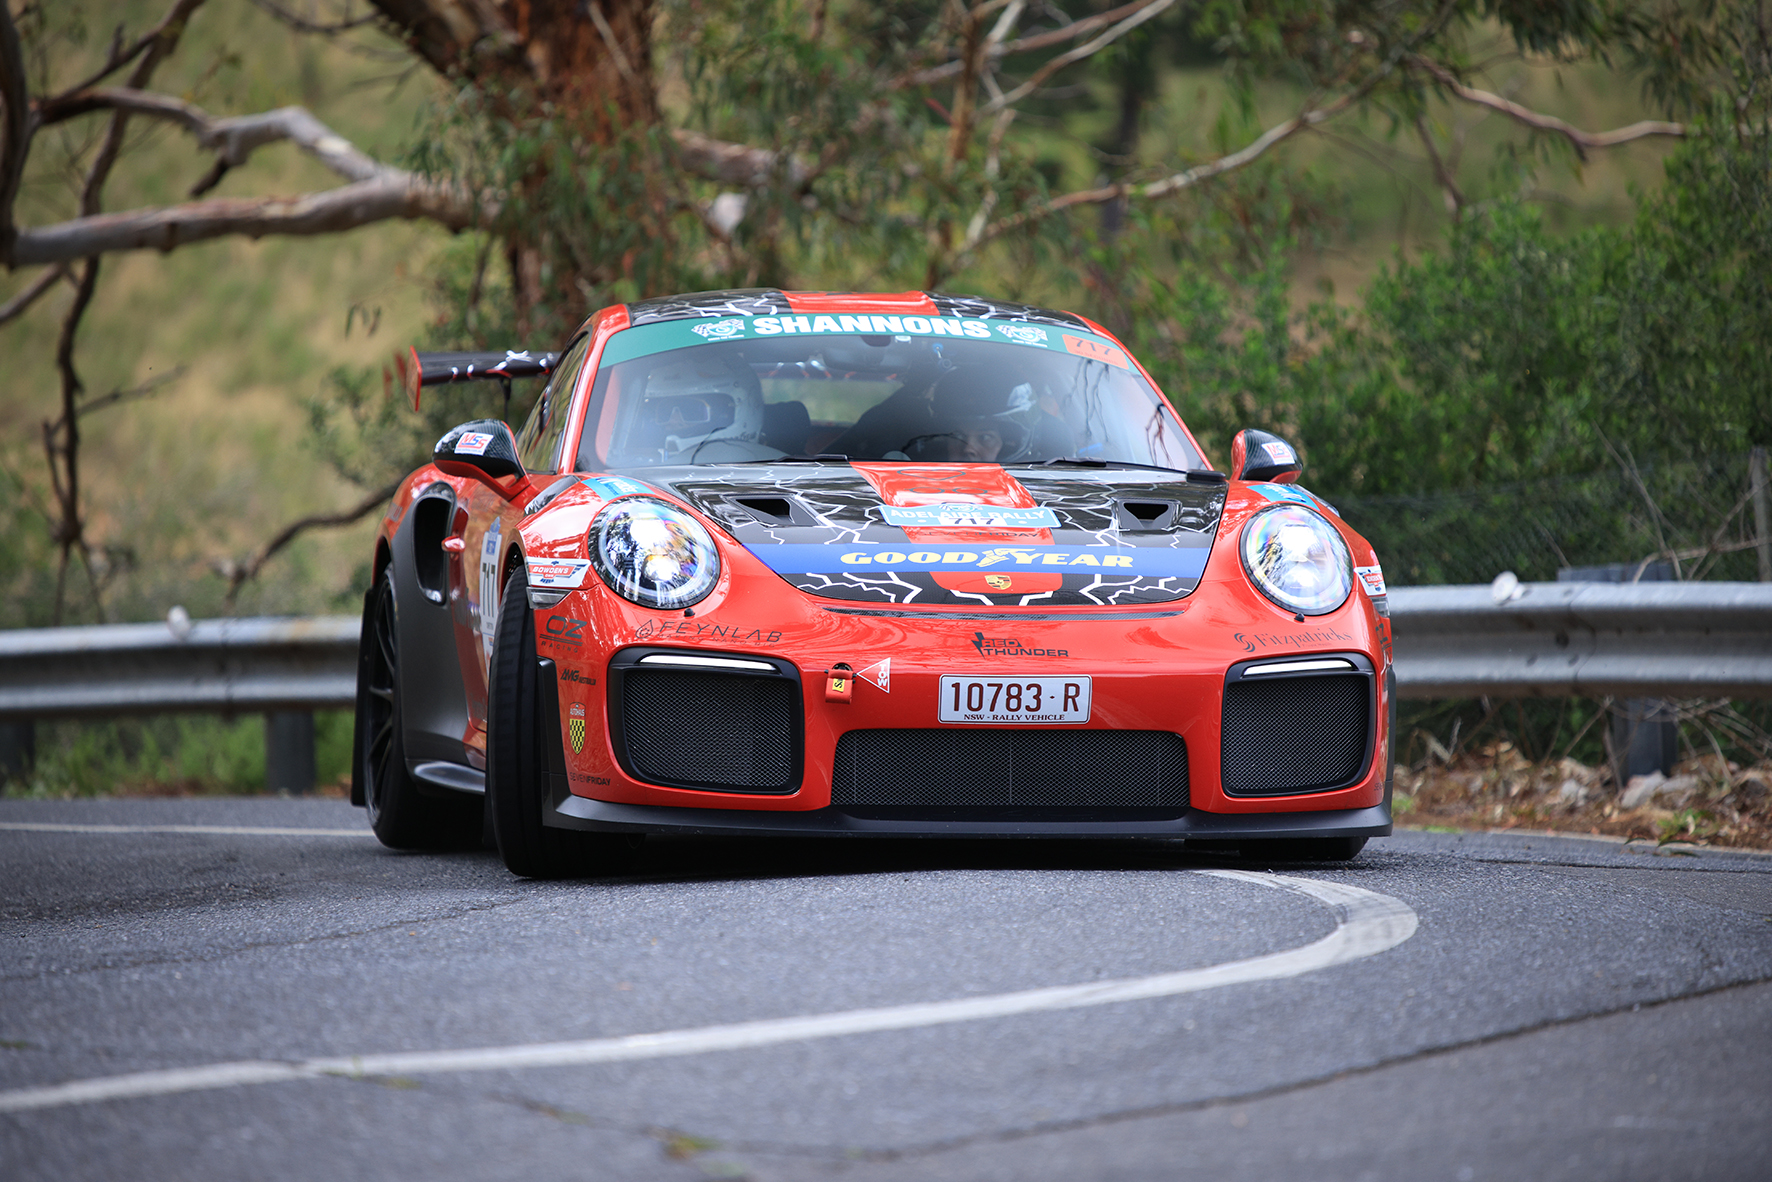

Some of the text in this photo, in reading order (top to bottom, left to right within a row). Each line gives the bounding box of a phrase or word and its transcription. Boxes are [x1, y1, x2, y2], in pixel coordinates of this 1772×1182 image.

[753, 314, 992, 339] SHANNONS
[1071, 336, 1111, 356] 717
[890, 508, 1046, 520] ADELAIDE RALLY
[948, 517, 995, 525] 717
[532, 566, 569, 575] BOWDEN'S
[546, 614, 588, 640] OZ
[659, 621, 783, 643] FEYNLAB
[981, 639, 1019, 648] RED
[1254, 628, 1354, 648] Fitzpatricks
[540, 640, 578, 653] RACING
[984, 648, 1069, 657] THUNDER
[569, 772, 611, 787] SEVENFRIDAY
